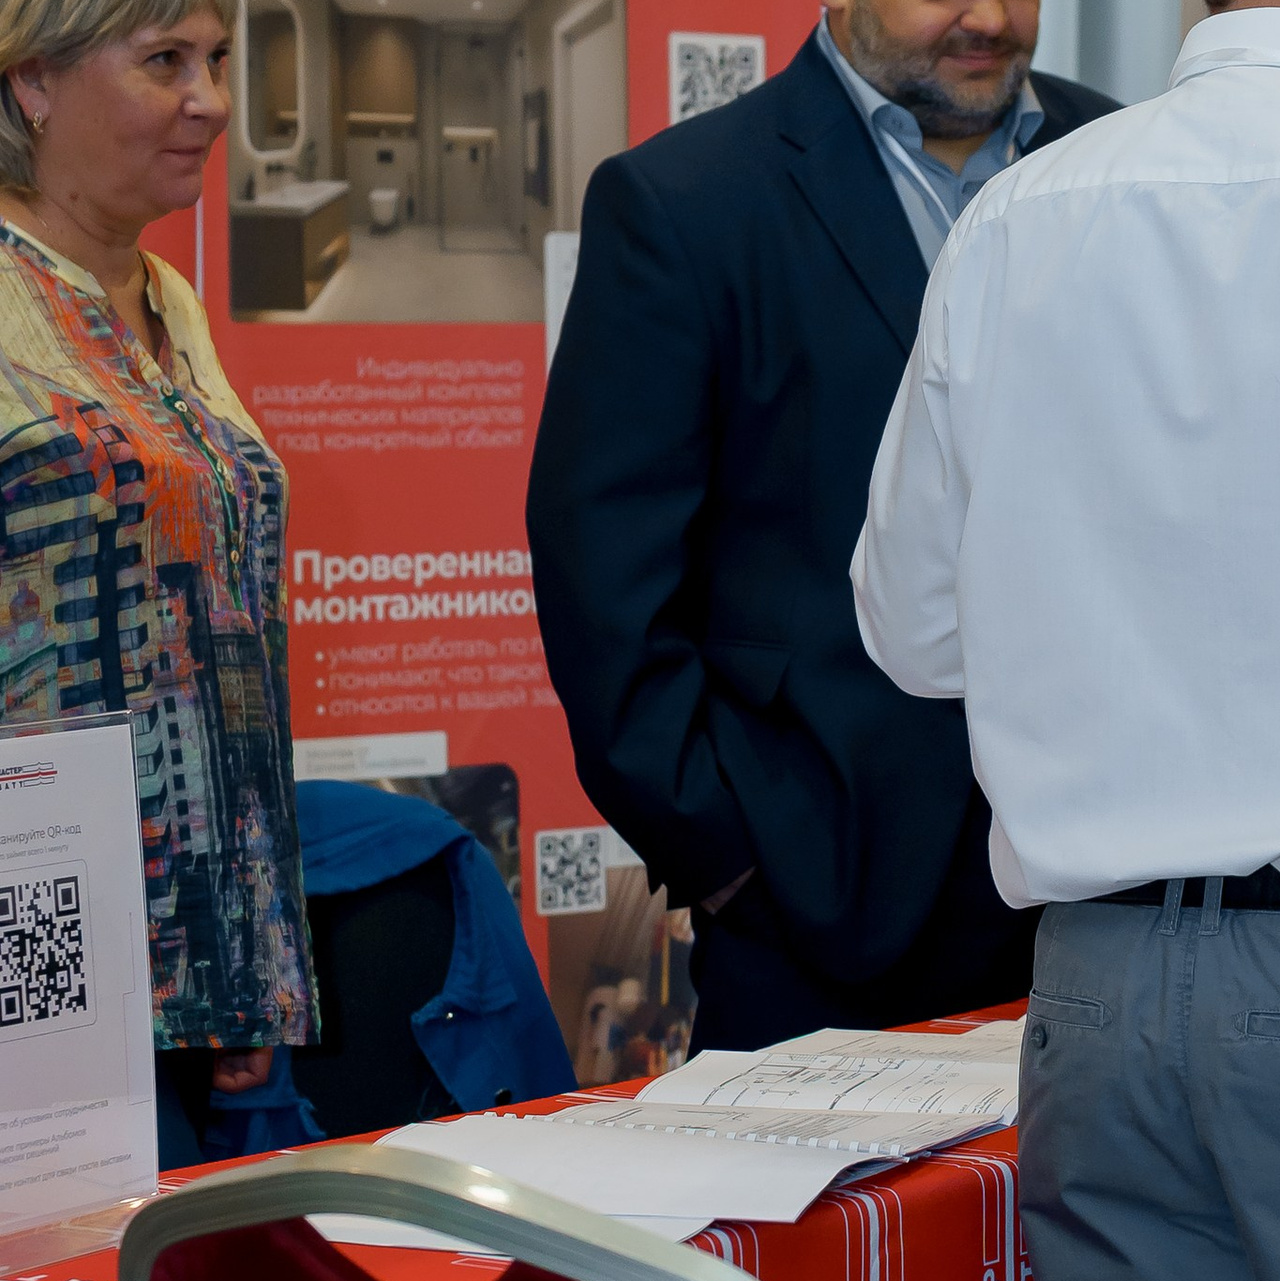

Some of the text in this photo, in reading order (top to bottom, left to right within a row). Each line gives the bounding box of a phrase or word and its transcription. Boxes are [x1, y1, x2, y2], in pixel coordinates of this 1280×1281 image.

[294, 588, 537, 624] монтажнико
[0, 824, 82, 845] анируйте QR-код
